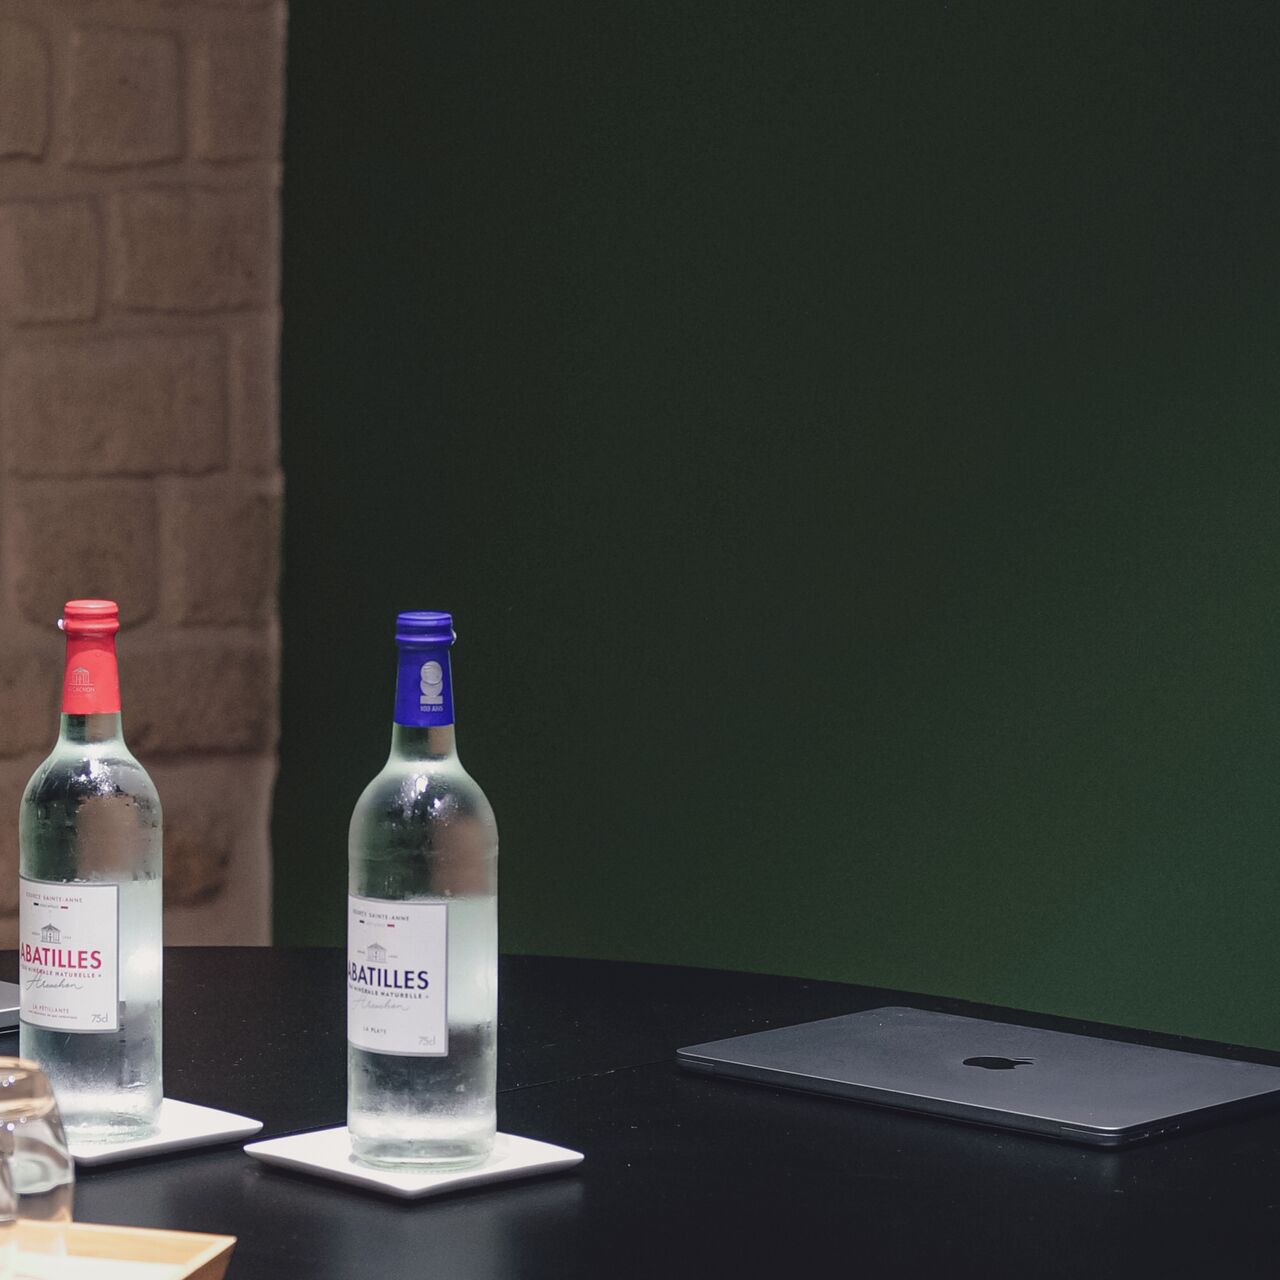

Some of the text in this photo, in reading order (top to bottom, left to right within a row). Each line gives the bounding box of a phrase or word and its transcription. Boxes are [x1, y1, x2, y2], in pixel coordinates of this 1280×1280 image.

[21, 942, 102, 969] ABATILLES
[55, 971, 95, 979] NATURELLE
[380, 991, 422, 999] NATURELLE
[91, 1012, 108, 1024] 75cl
[370, 1027, 387, 1035] PLATE
[418, 1035, 436, 1047] 75cl
